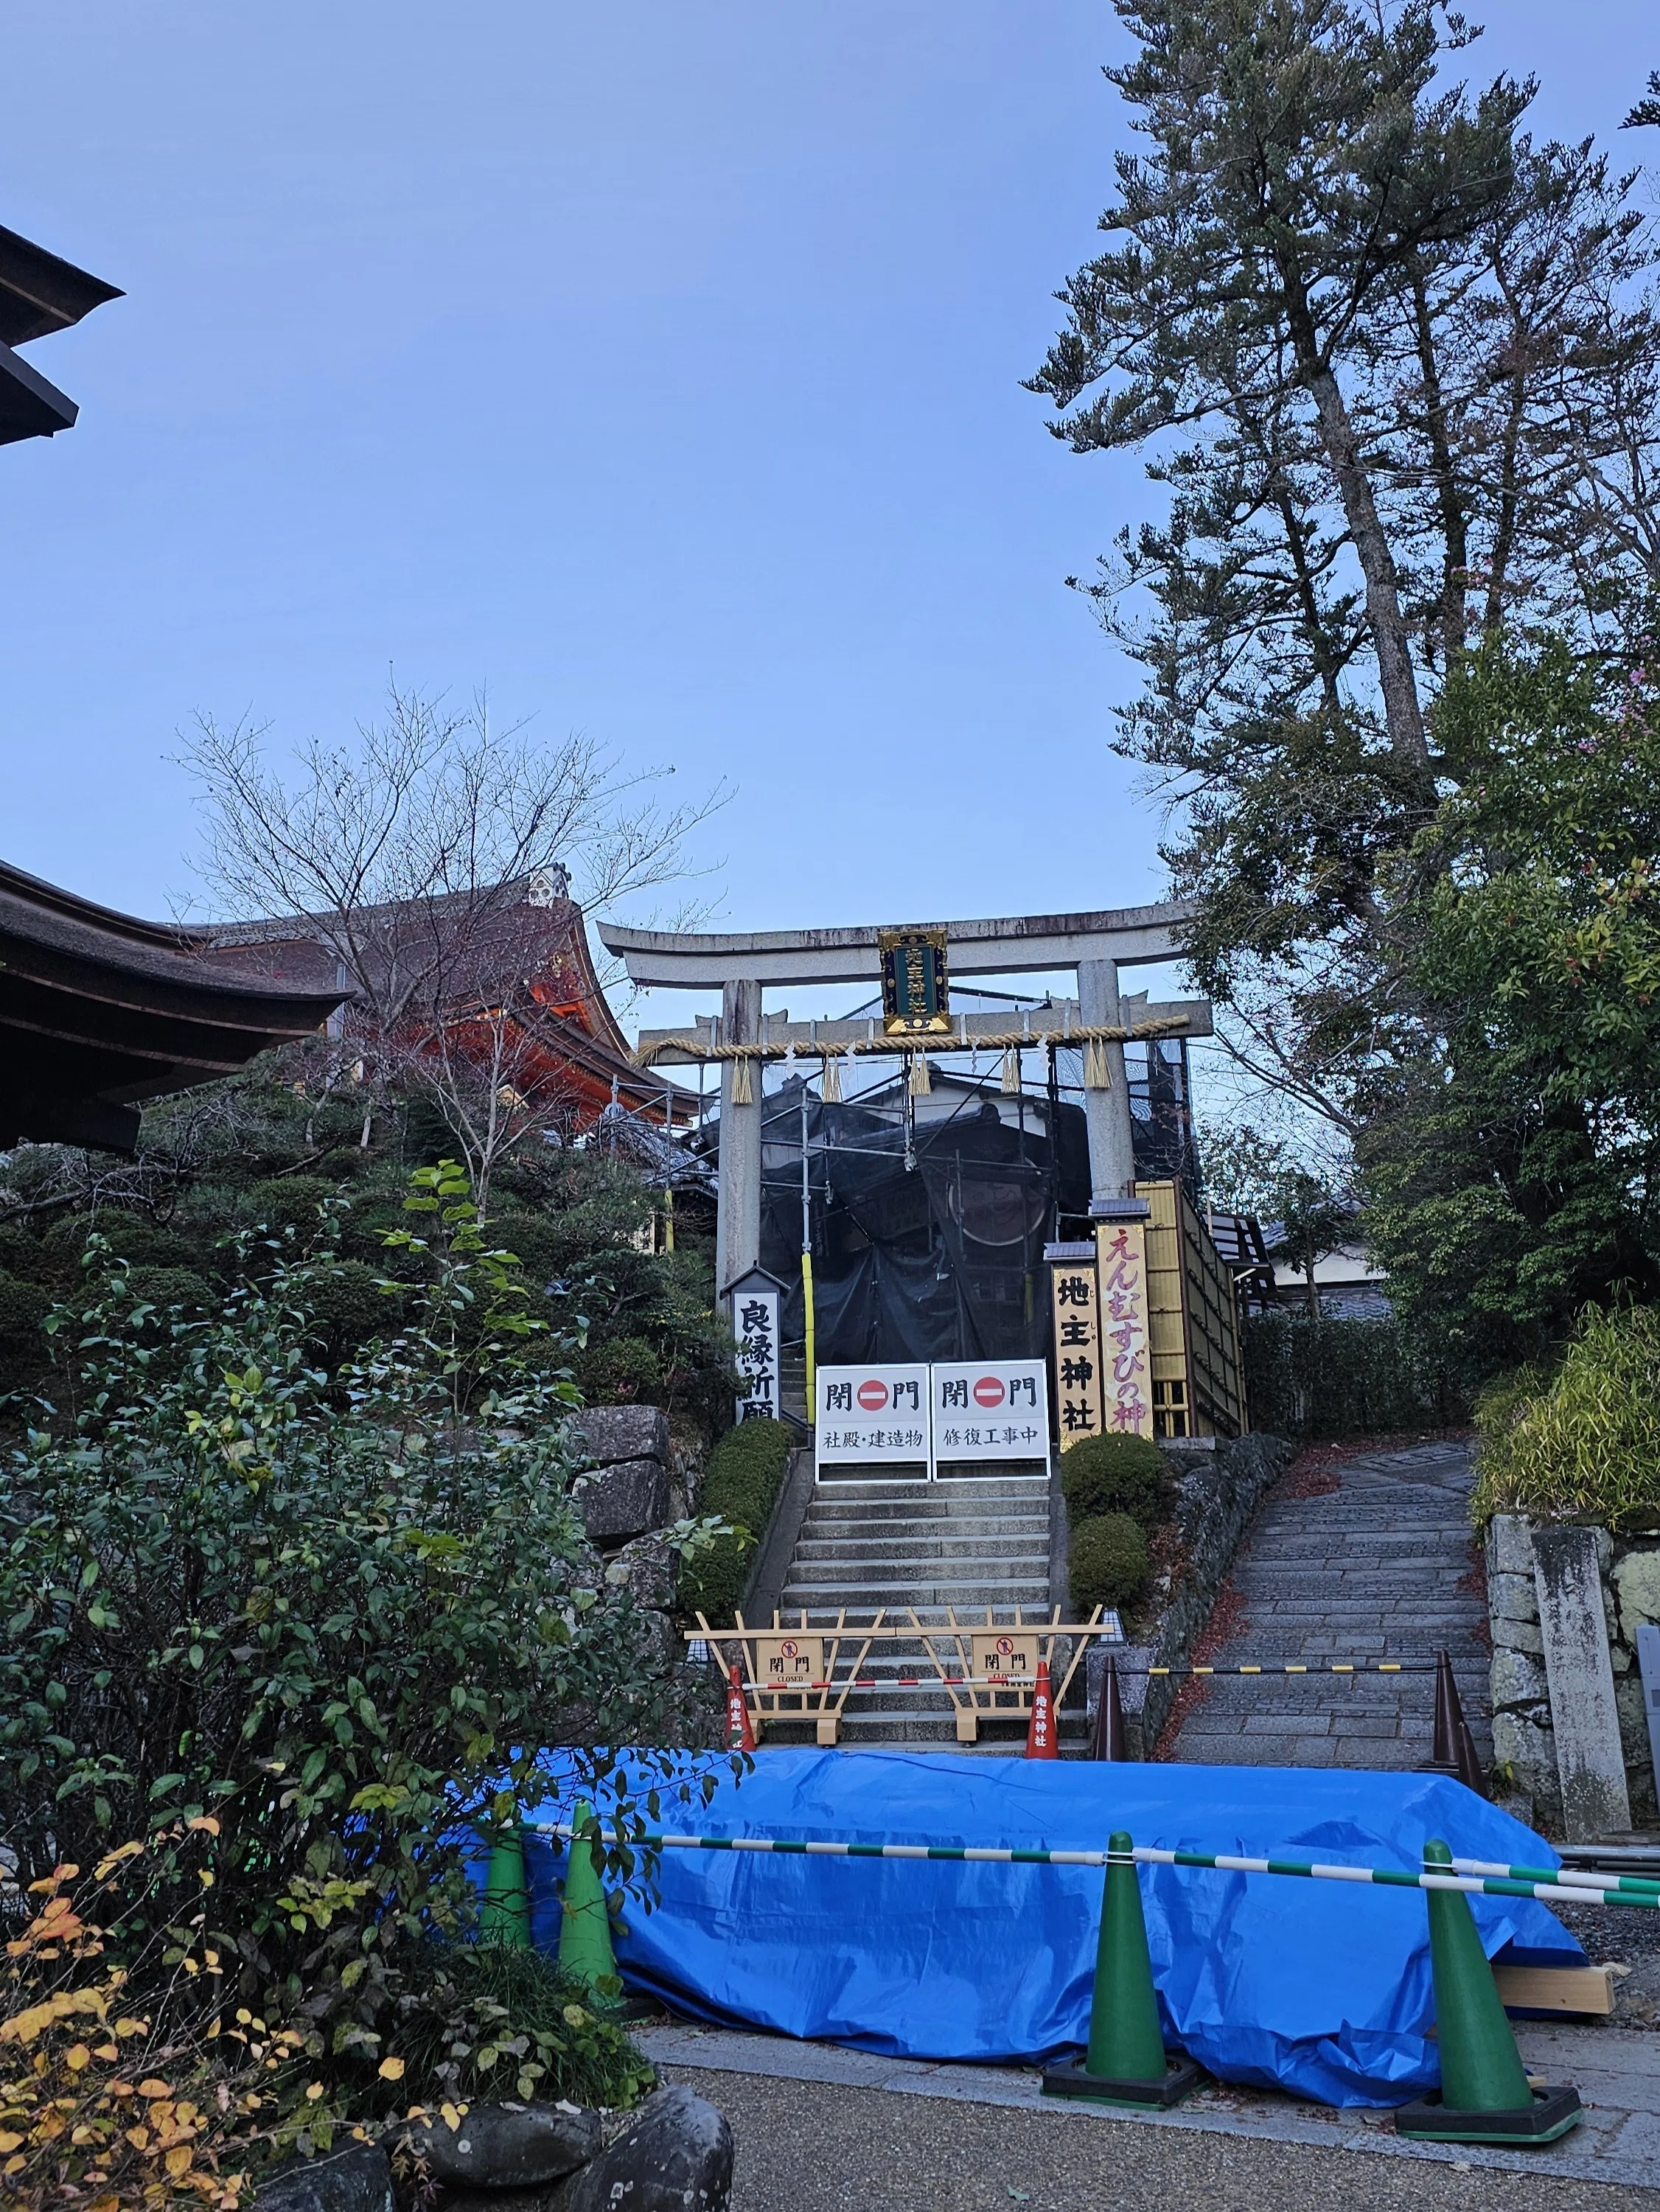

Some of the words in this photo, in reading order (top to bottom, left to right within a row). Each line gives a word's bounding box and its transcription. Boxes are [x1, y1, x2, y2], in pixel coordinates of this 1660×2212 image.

[1106, 1228, 1146, 1434] えんむすびの神
[1058, 1276, 1096, 1431] 地主神社
[826, 1382, 852, 1411] 閉
[893, 1381, 919, 1411] 門
[942, 1379, 969, 1409] 閉
[1009, 1376, 1037, 1407] 門
[823, 1429, 923, 1448] 社殿・建造物
[943, 1426, 1039, 1446] 修復工事中
[1035, 1695, 1047, 1747] 地主神社
